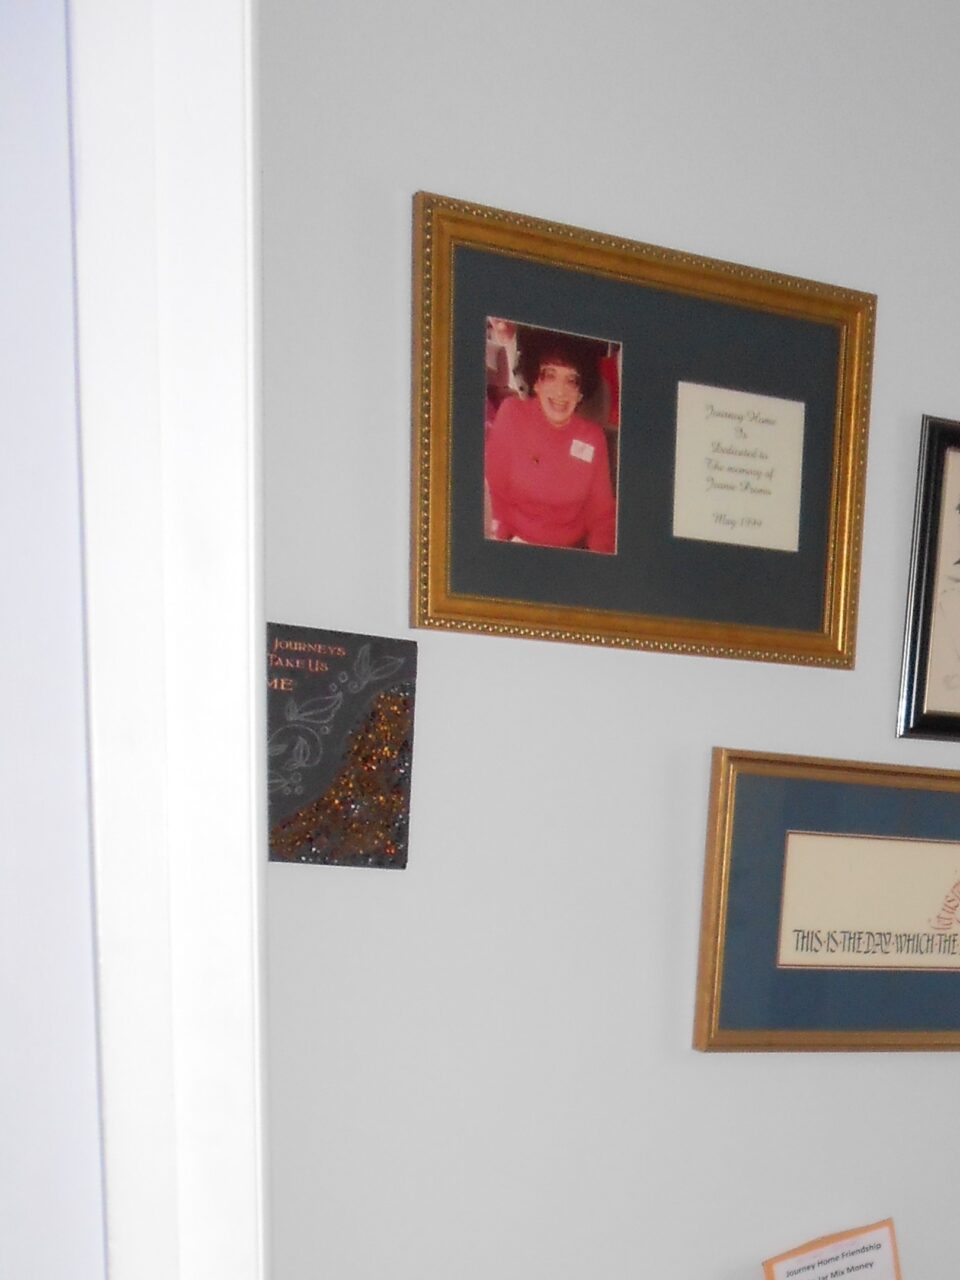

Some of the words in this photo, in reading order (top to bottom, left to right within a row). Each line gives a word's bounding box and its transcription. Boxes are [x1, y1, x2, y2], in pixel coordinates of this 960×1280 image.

[273, 637, 346, 656] JOURNEYS
[308, 658, 329, 672] US
[792, 929, 823, 953] THIS
[826, 930, 839, 953] IS
[840, 930, 864, 953] THE
[863, 931, 892, 954] DAY
[895, 932, 934, 955] WHICH
[937, 933, 958, 955] THE
[786, 1263, 816, 1278] Journey
[817, 1255, 840, 1269] Home
[841, 1242, 882, 1258] Friendship
[830, 1269, 845, 1279] Mix
